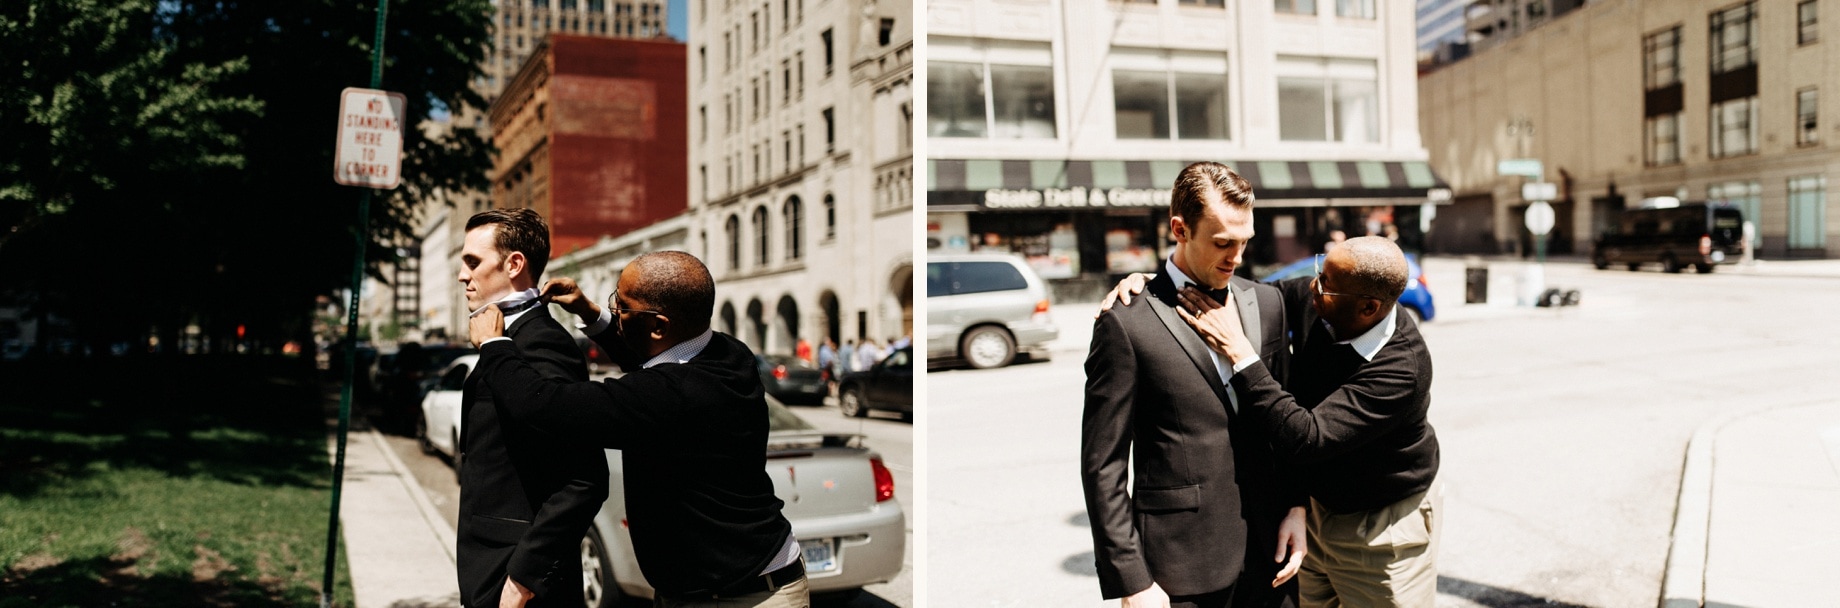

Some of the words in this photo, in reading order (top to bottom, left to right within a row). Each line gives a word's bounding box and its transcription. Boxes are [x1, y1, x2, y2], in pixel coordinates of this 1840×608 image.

[367, 100, 382, 113] NO
[345, 113, 399, 131] STANDING
[355, 132, 382, 147] HERE
[362, 147, 375, 161] TO
[346, 162, 388, 177] CORNER
[985, 188, 1042, 208] State
[1044, 186, 1087, 207] Deli
[1089, 187, 1107, 207] &
